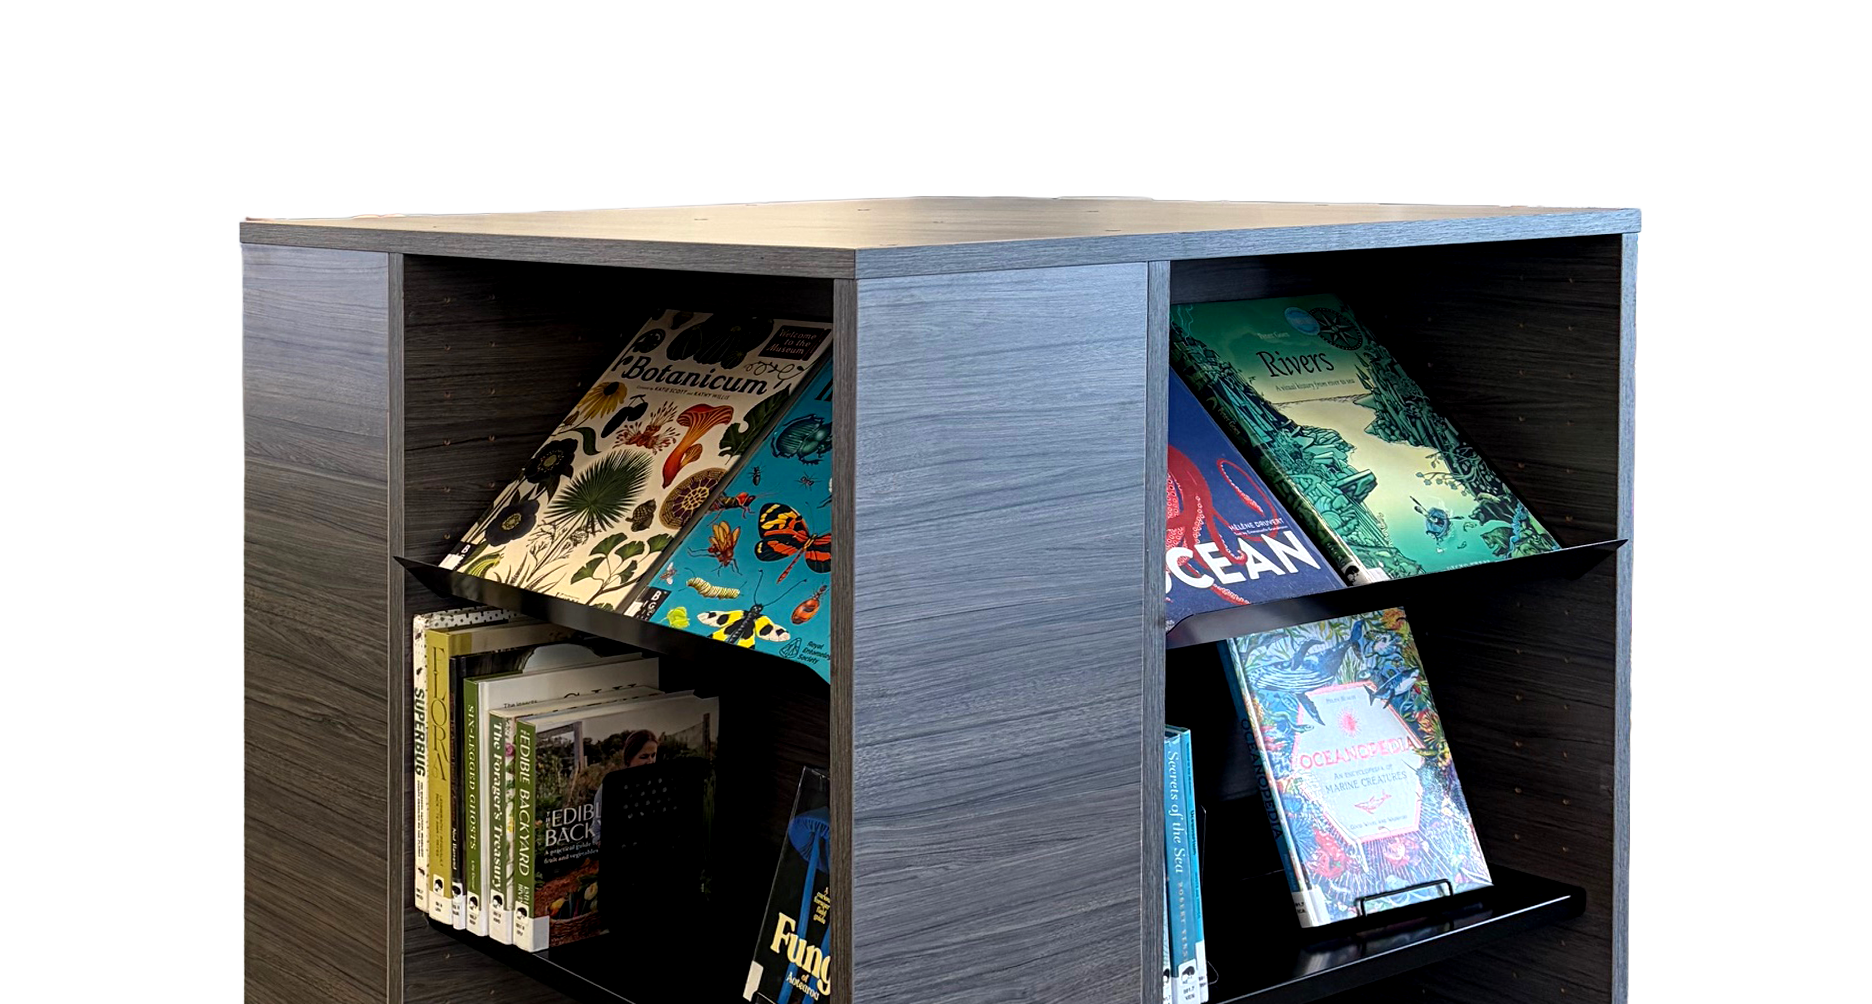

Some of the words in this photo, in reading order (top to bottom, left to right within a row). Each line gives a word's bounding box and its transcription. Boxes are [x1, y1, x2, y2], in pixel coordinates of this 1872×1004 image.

[766, 343, 805, 355] Museum
[780, 329, 817, 340] Welcome
[784, 338, 794, 346] to
[796, 339, 812, 347] the
[621, 355, 768, 396] Botanicum
[1256, 350, 1335, 377] Rivers
[807, 640, 825, 650] Royal
[414, 688, 426, 778] SUPERBUG
[468, 704, 477, 791] SIX-LEGGED
[493, 722, 503, 750] The
[519, 735, 531, 784] EDIBLE
[1300, 735, 1416, 770] OCEANOPEDIA
[492, 753, 502, 818] Forager's
[1168, 750, 1180, 801] Secrets
[1240, 718, 1284, 840] OCEANOPEDIA
[1325, 780, 1360, 794] MARINE
[1360, 770, 1408, 788] CREATURES
[469, 794, 477, 850] GHOSTS
[551, 801, 602, 828] EDIBL
[1169, 804, 1184, 821] of
[518, 789, 530, 876] BACKYARD
[545, 822, 596, 847] BACK
[1172, 822, 1188, 844] the
[491, 823, 503, 892] Treasury
[1174, 848, 1186, 874] Sea
[770, 911, 830, 996] Fung
